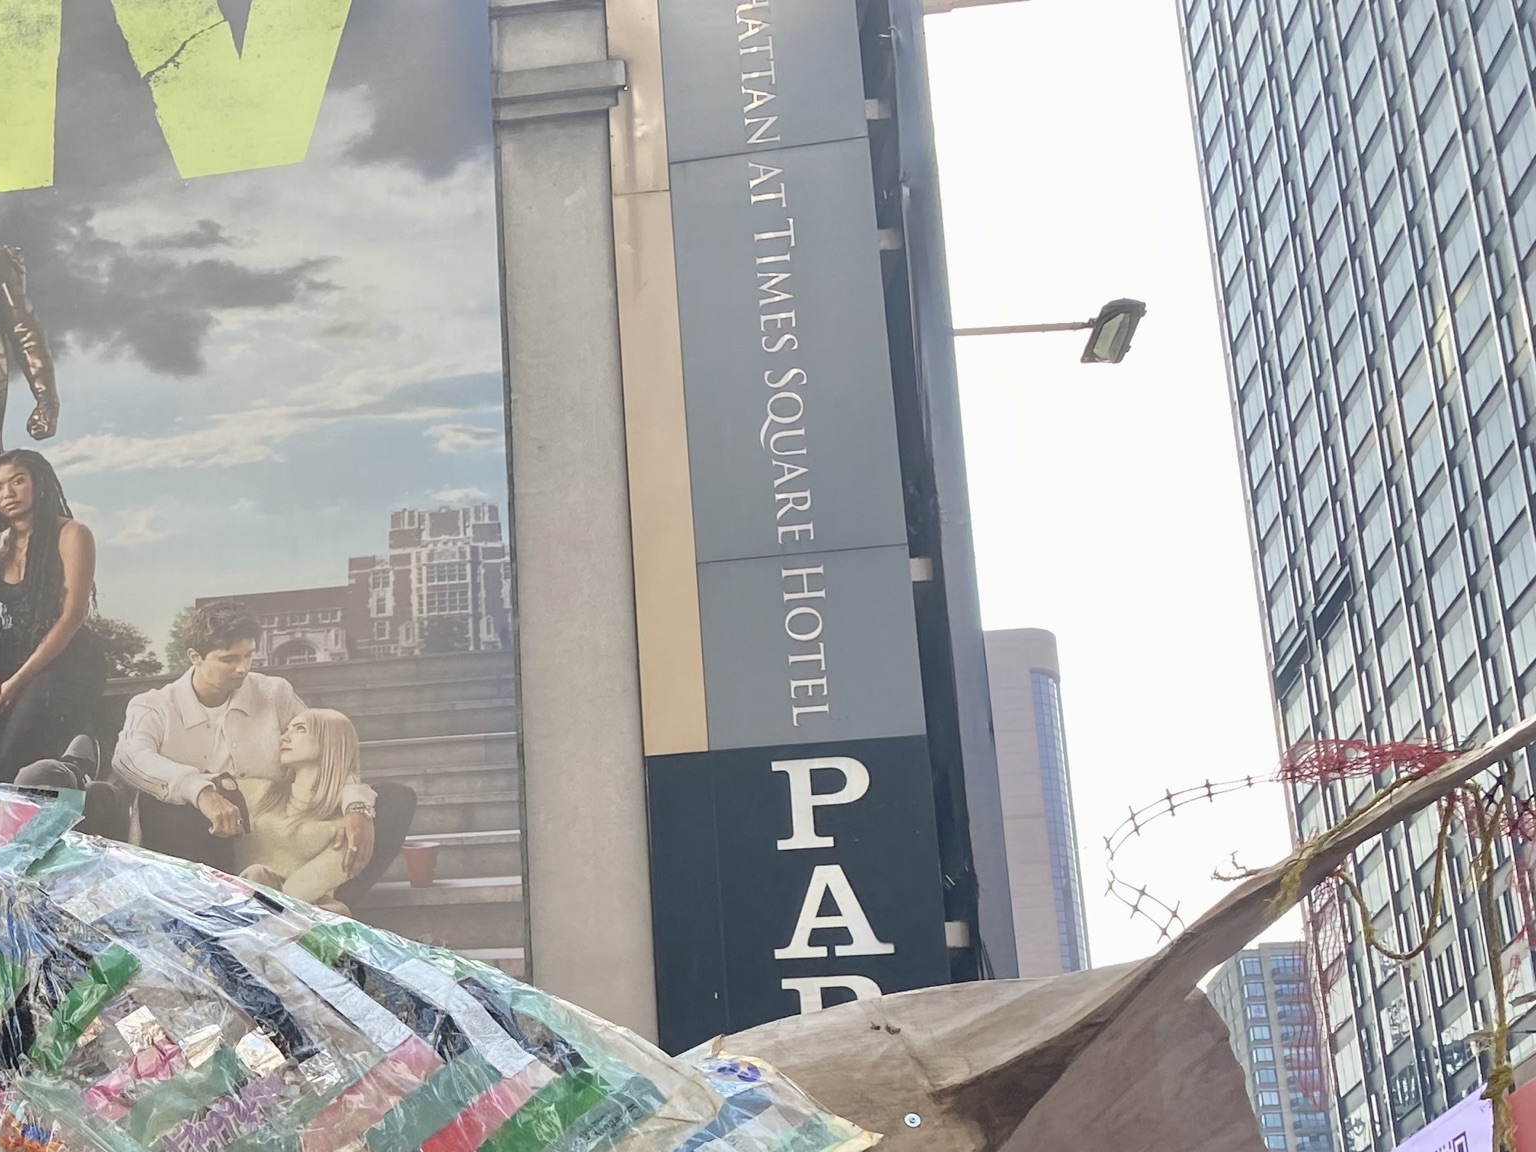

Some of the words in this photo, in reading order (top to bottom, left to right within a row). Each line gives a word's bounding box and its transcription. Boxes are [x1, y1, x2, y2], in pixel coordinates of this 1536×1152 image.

[115, 0, 352, 179] V
[748, 161, 787, 208] AT
[753, 218, 798, 353] TIMES
[760, 368, 815, 544] SQUARE
[781, 565, 830, 727] HOTEL
